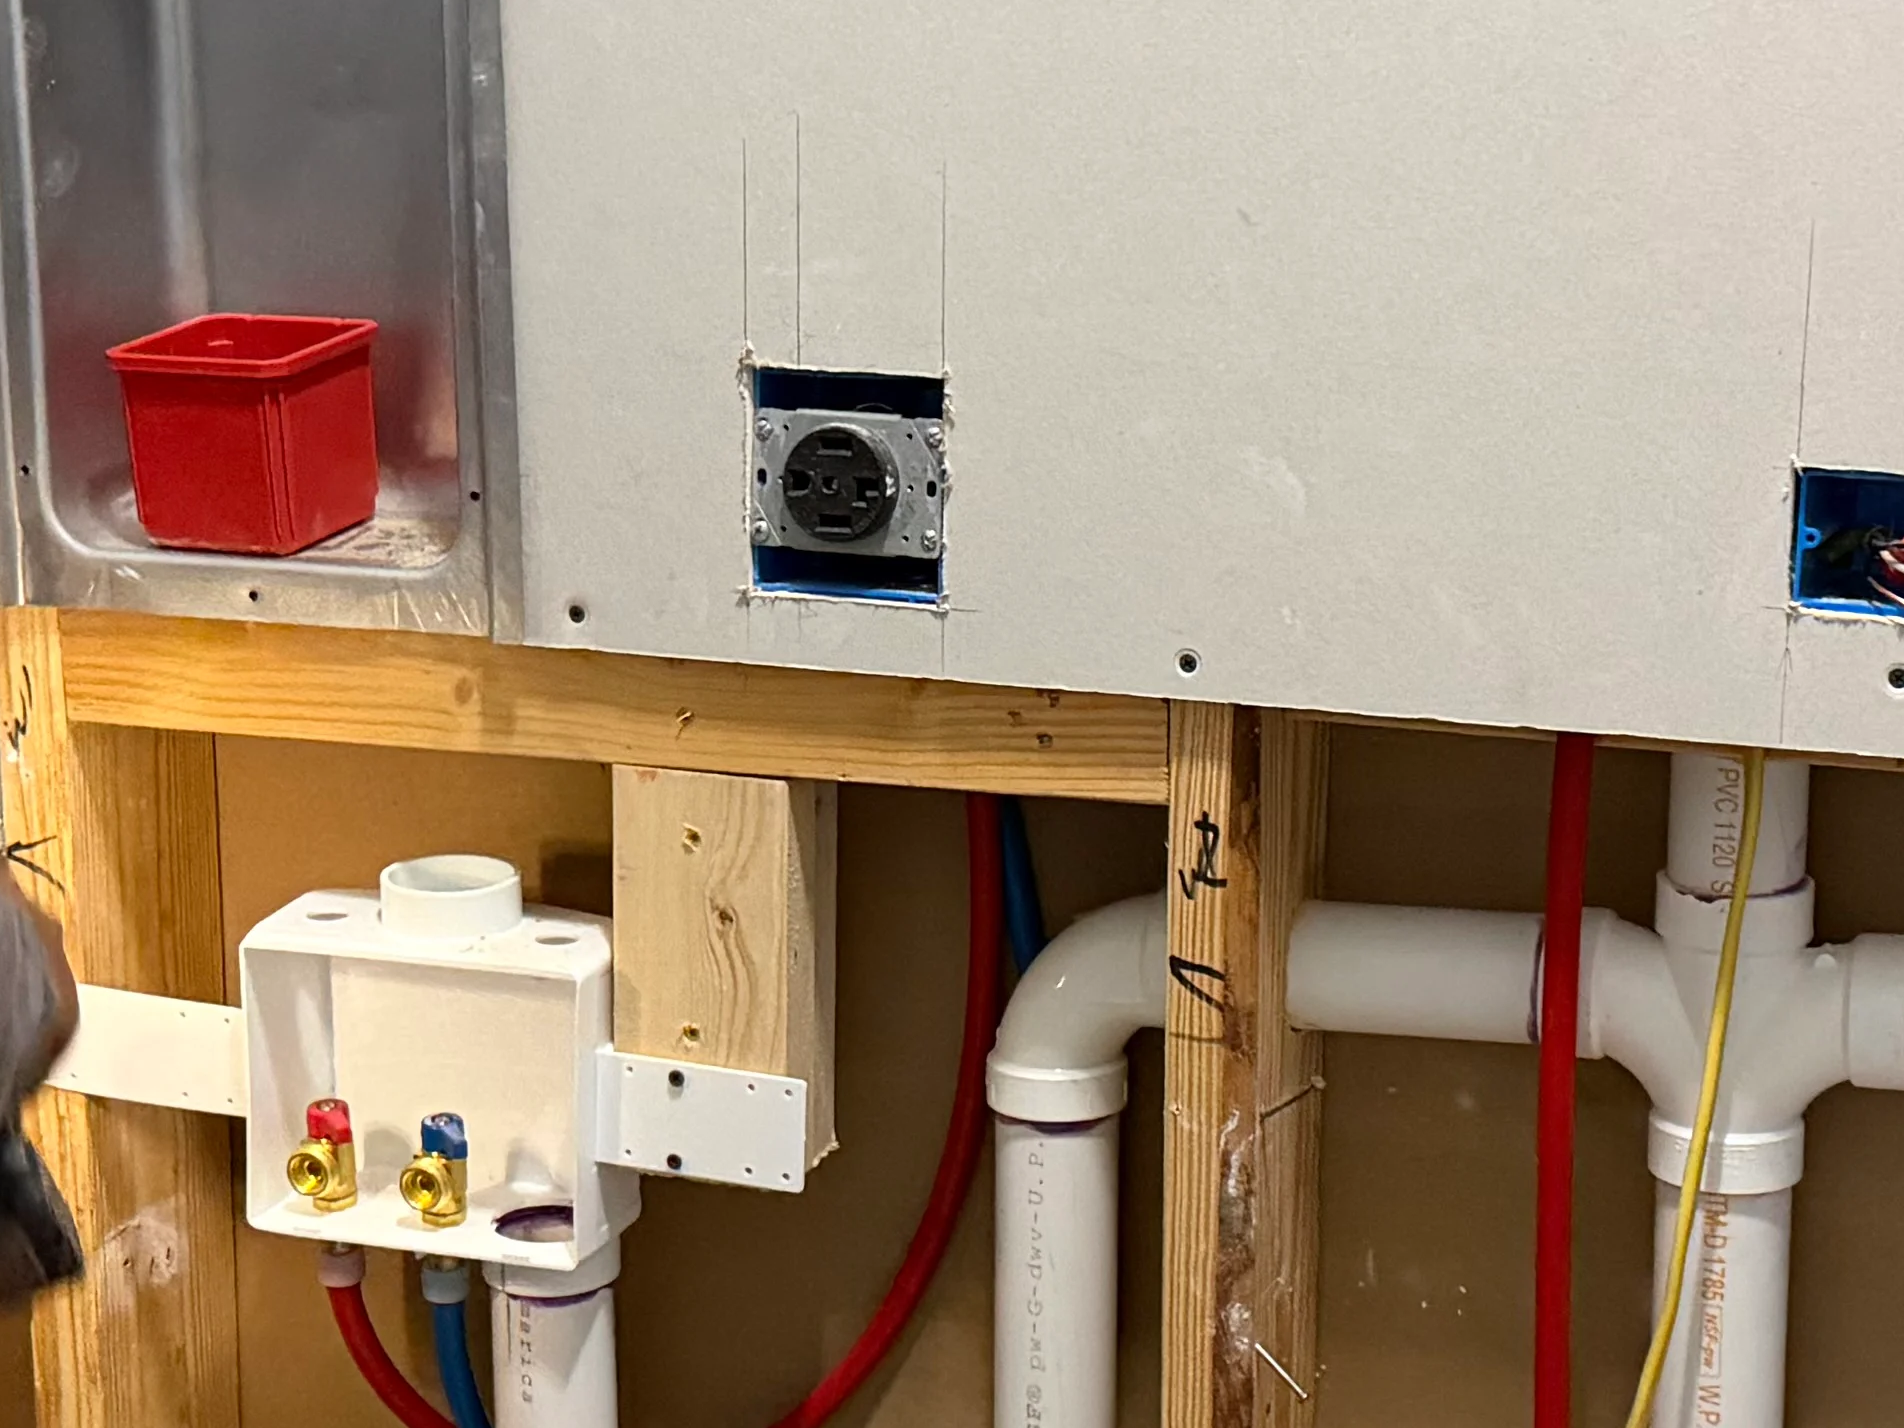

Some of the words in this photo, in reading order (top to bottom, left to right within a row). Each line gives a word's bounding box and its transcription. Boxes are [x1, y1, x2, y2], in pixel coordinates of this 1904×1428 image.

[1714, 768, 1740, 812] PVC
[1711, 823, 1737, 868] 1120
[1702, 1257, 1725, 1301] 1785
[1697, 1385, 1722, 1428] W.P.
